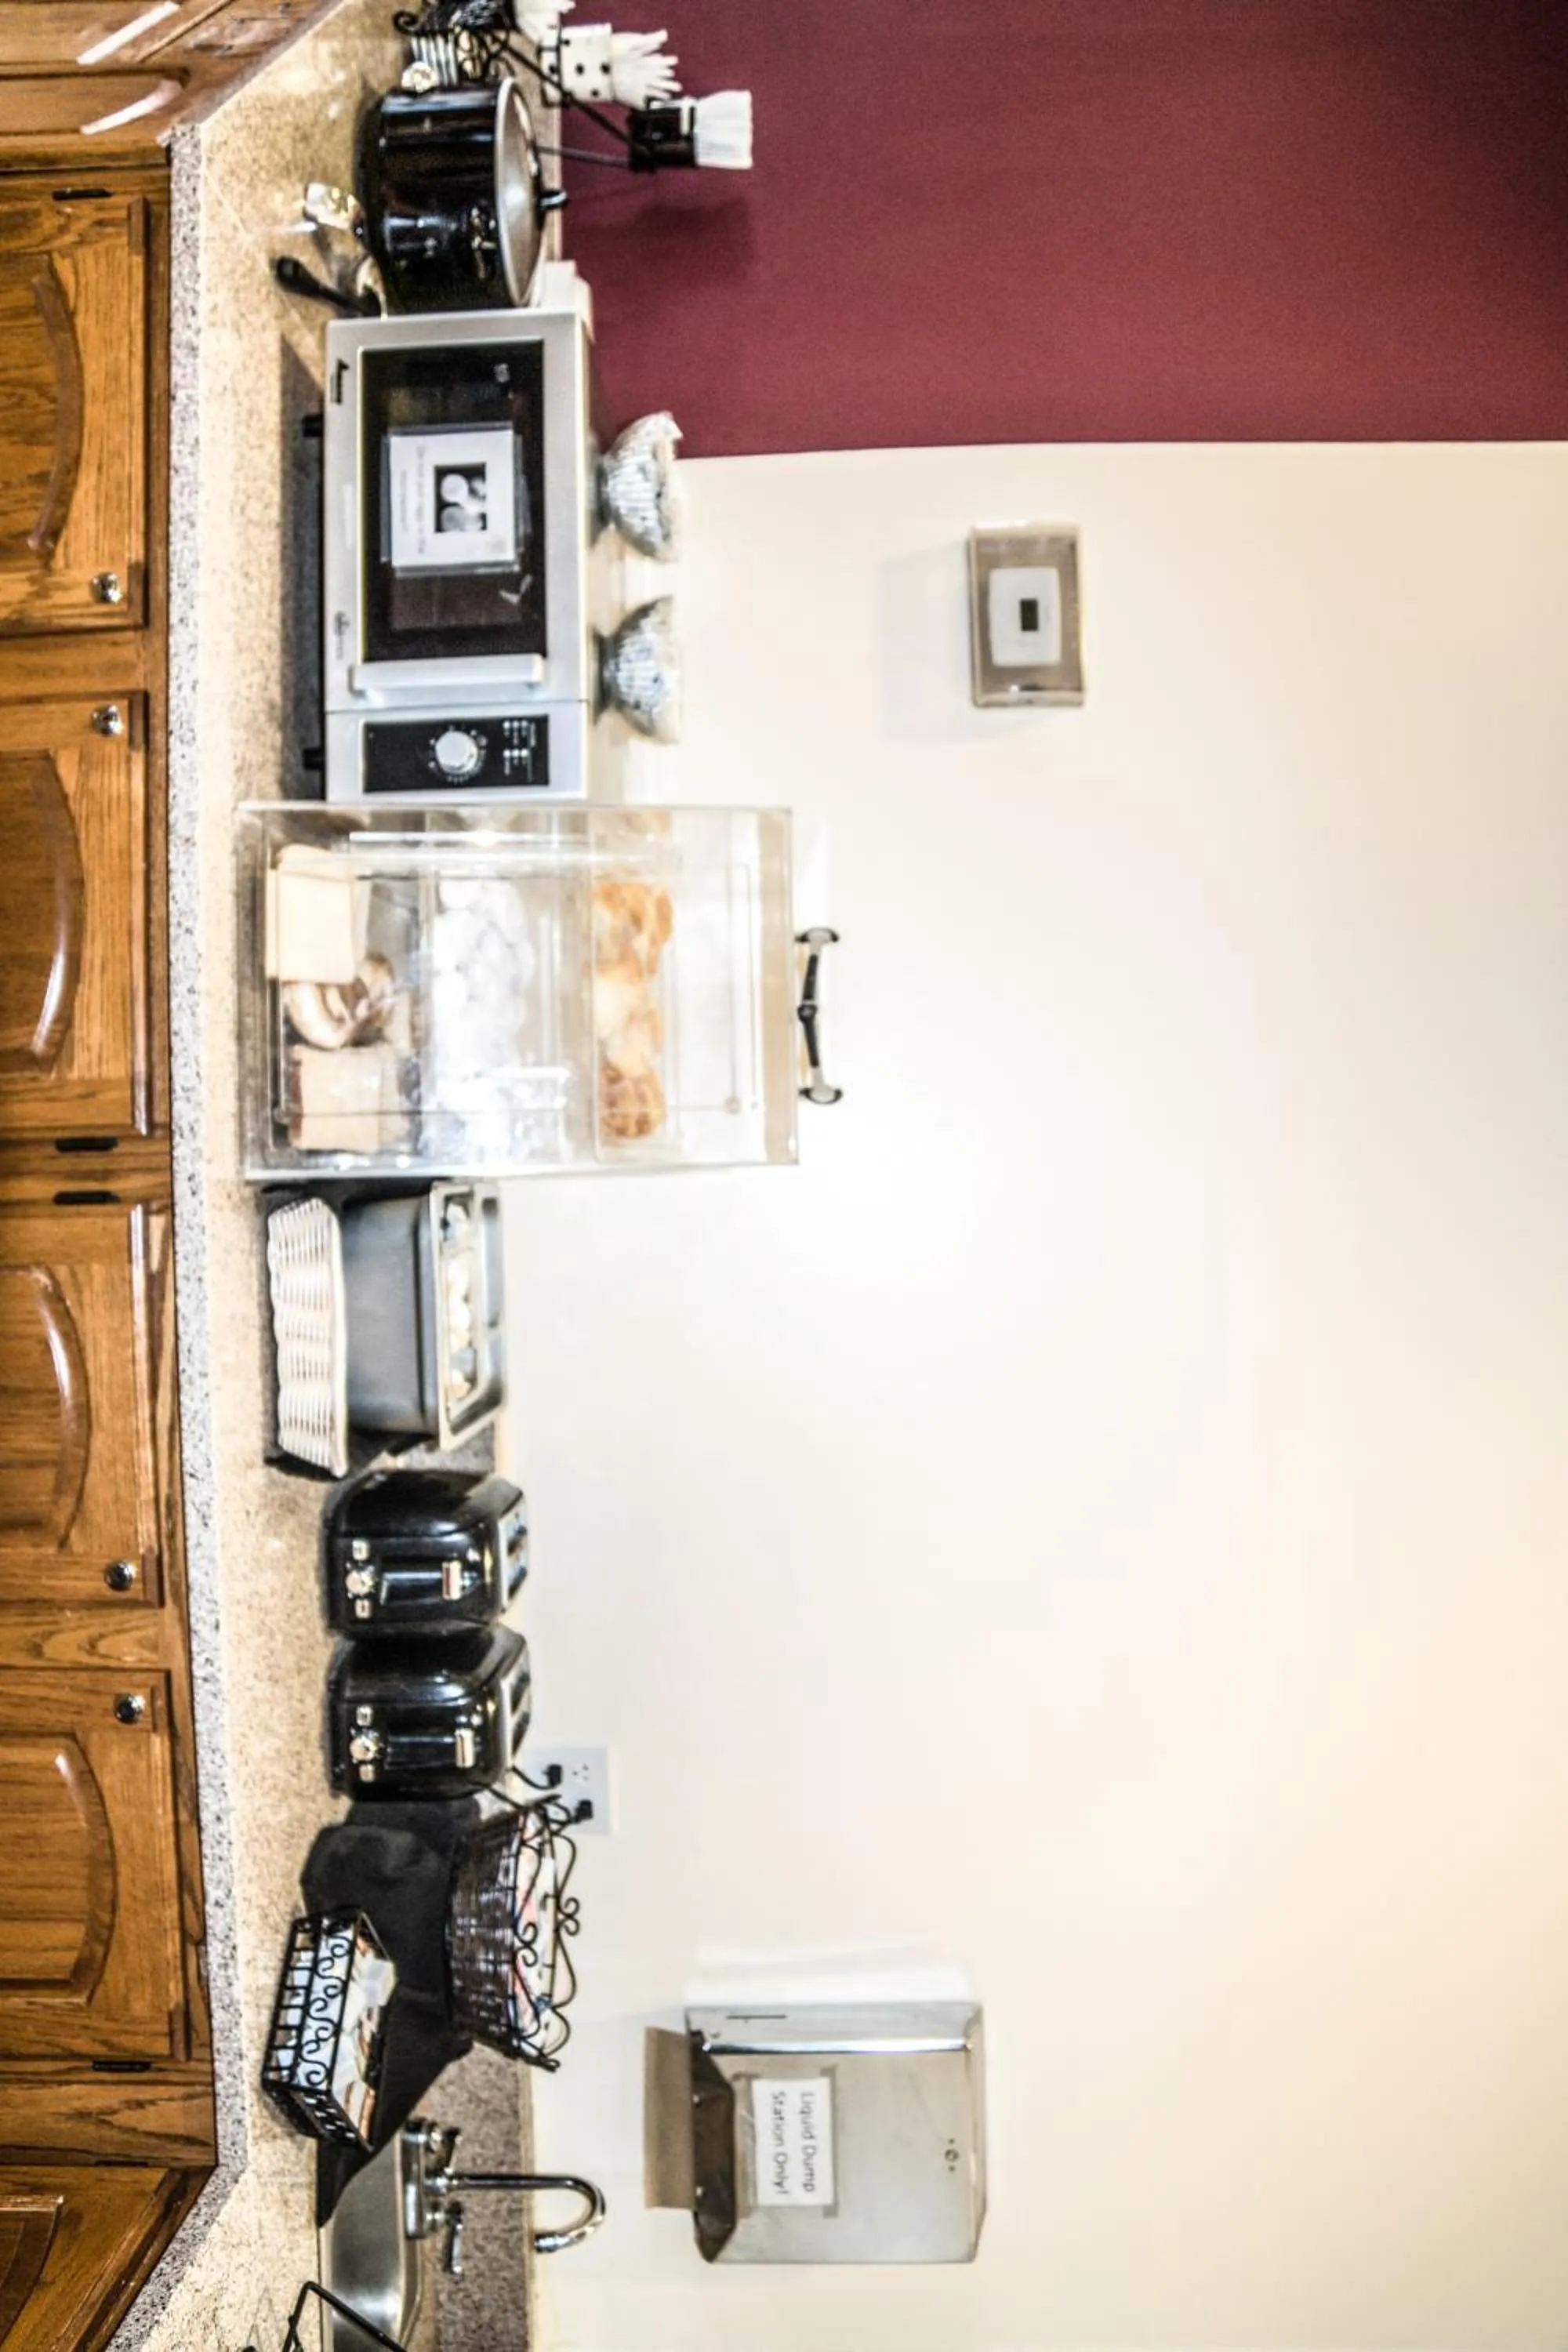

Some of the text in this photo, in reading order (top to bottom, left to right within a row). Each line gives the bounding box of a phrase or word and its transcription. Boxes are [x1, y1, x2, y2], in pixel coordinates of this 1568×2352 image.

[772, 2091, 789, 2194] Station Only!
[799, 2092, 816, 2192] Liquid Dump
